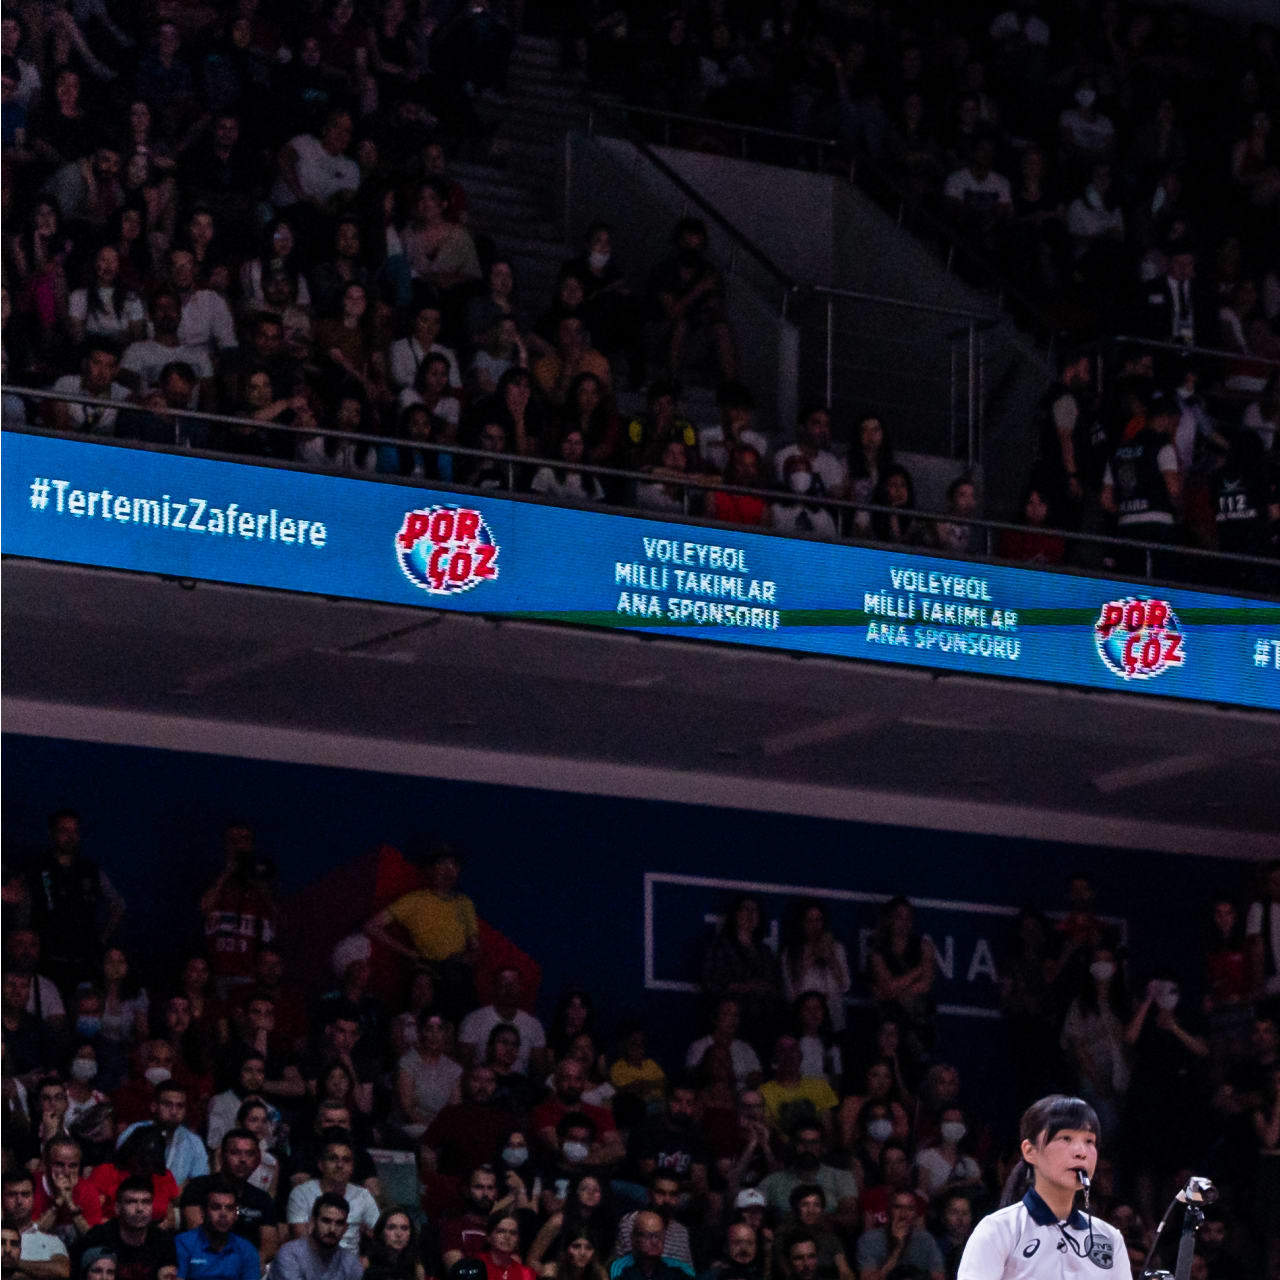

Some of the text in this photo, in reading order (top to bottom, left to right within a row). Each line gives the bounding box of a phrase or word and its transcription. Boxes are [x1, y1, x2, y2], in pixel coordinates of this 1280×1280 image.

[30, 479, 327, 547] #TertemizZaferlere
[398, 510, 481, 550] POR
[643, 538, 749, 573] VOLEYBOL
[616, 561, 776, 603] MİLLİ TAKIMLAR
[890, 567, 992, 601] VOLEYBOL
[617, 592, 781, 630] ANA SPONSORU
[922, 599, 1018, 632] TAKIMLAR
[1097, 601, 1167, 638] POR
[866, 621, 1021, 661] ANA SPONSORU
